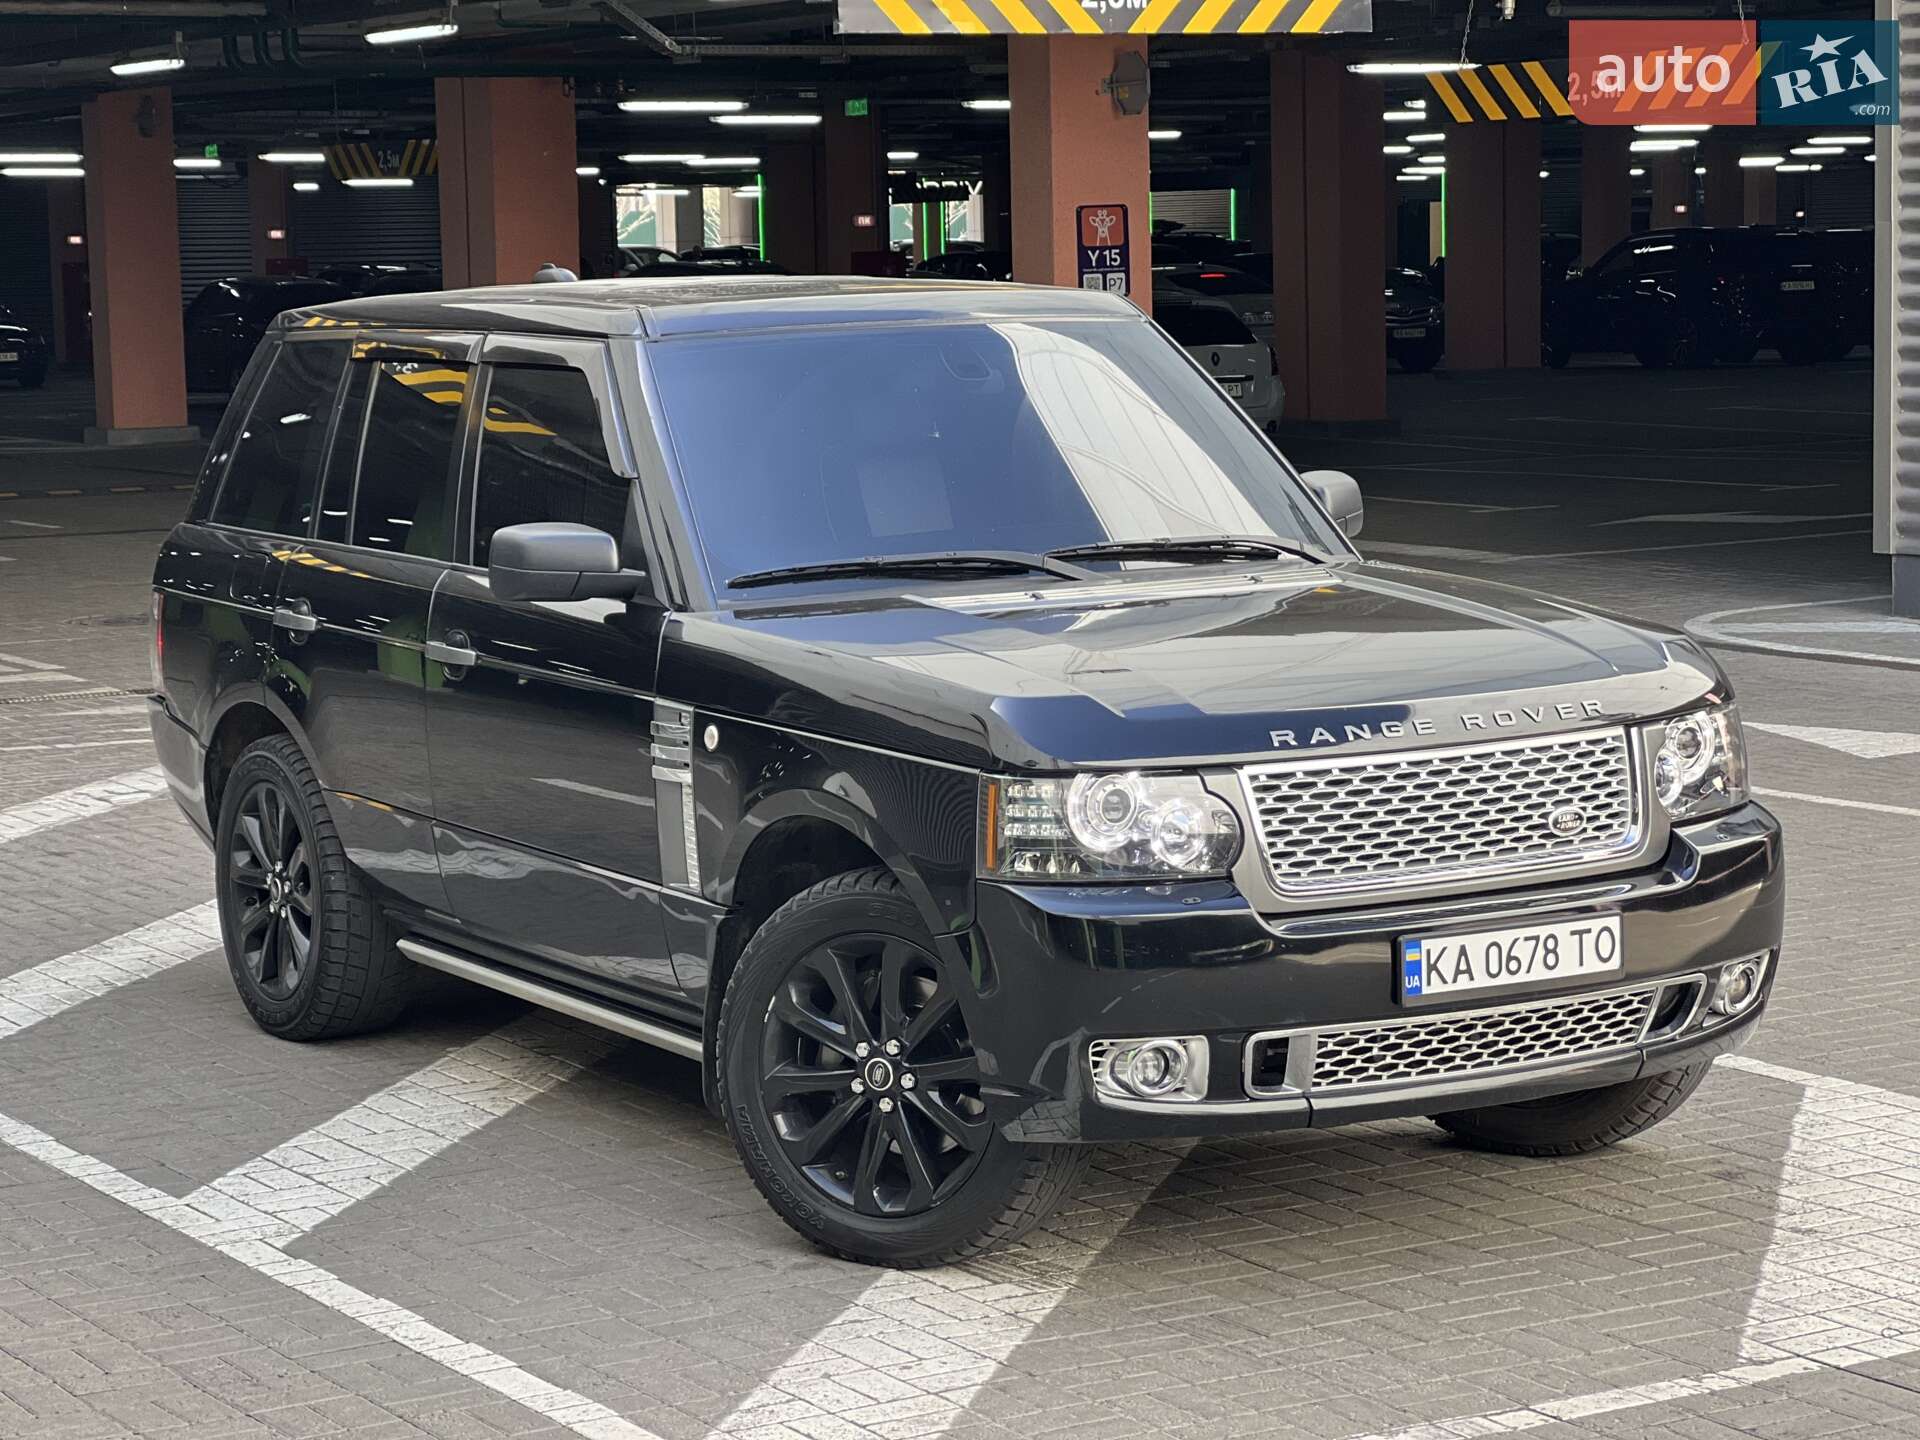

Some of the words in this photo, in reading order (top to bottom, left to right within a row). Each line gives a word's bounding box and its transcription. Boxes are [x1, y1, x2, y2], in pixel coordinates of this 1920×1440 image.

[1087, 249, 1100, 267] Y
[1102, 249, 1121, 266] 15
[1269, 717, 1437, 748] RANGE
[1461, 699, 1603, 731] ROVER
[1425, 943, 1475, 987] KA
[1484, 932, 1560, 979] 0678
[1569, 925, 1616, 967] TO
[1405, 974, 1421, 989] UA
